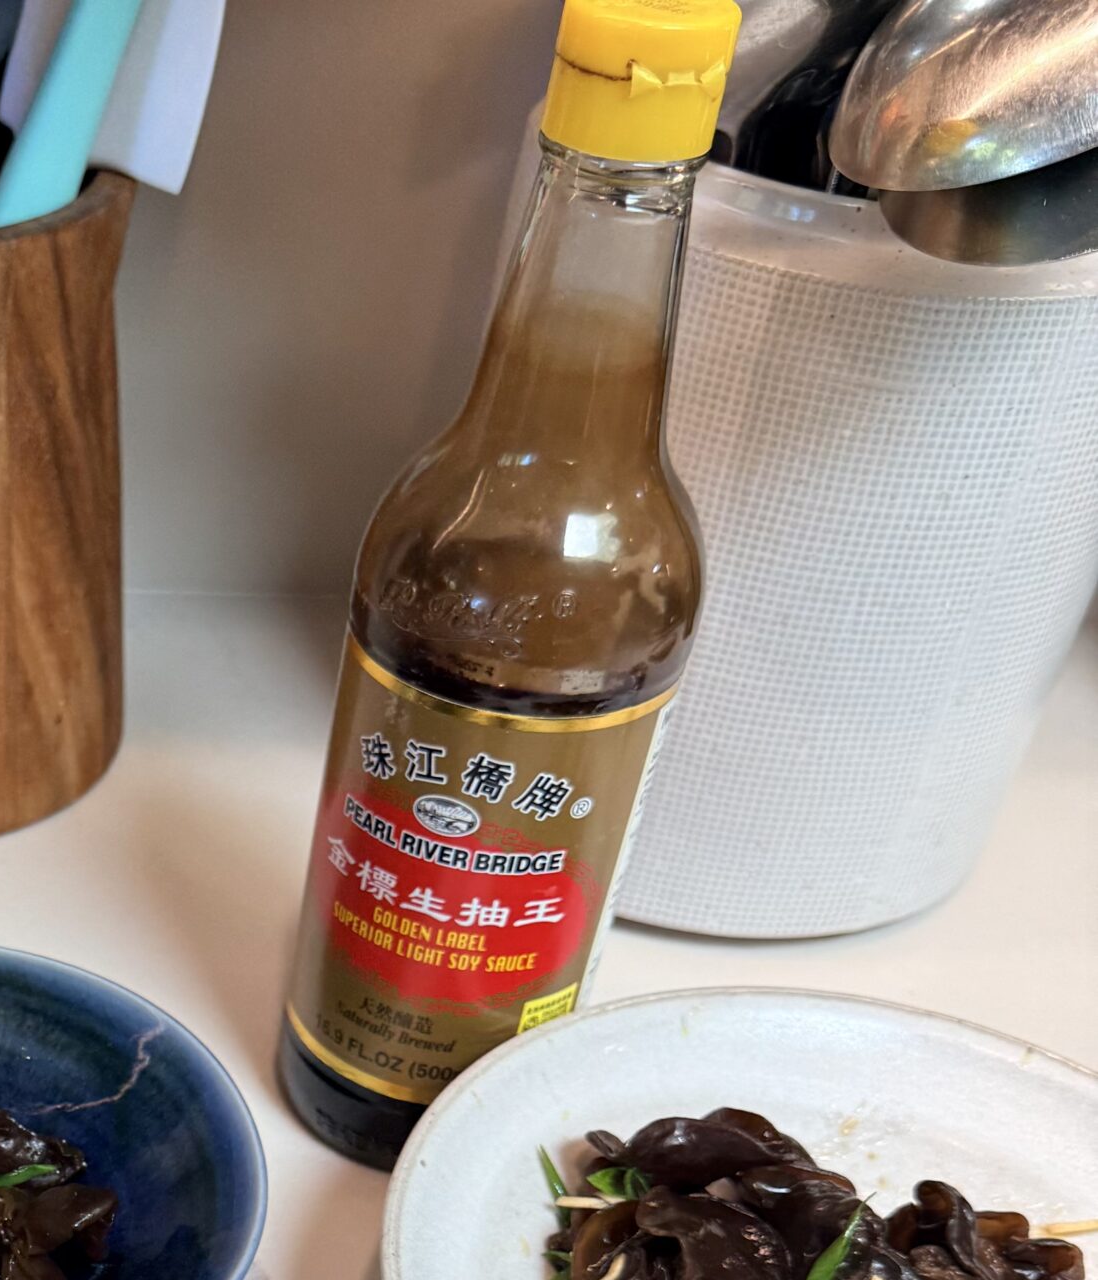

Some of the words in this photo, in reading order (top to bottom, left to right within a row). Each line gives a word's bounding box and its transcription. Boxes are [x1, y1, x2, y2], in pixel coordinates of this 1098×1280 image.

[362, 734, 573, 821] 珠江橋牌
[345, 795, 397, 848] PEARL
[399, 831, 469, 872] RIVER
[472, 849, 566, 875] BRIDGE
[328, 836, 566, 928] 金標生抽王
[333, 901, 394, 951] SUPERIOR
[396, 938, 445, 967] LIGHT
[447, 953, 482, 972] SOY
[485, 952, 538, 973] SAUCE
[373, 905, 433, 943] GOLDEN
[435, 929, 487, 952] LABEL
[335, 1000, 395, 1042] Naturally
[398, 1032, 458, 1053] Brewed
